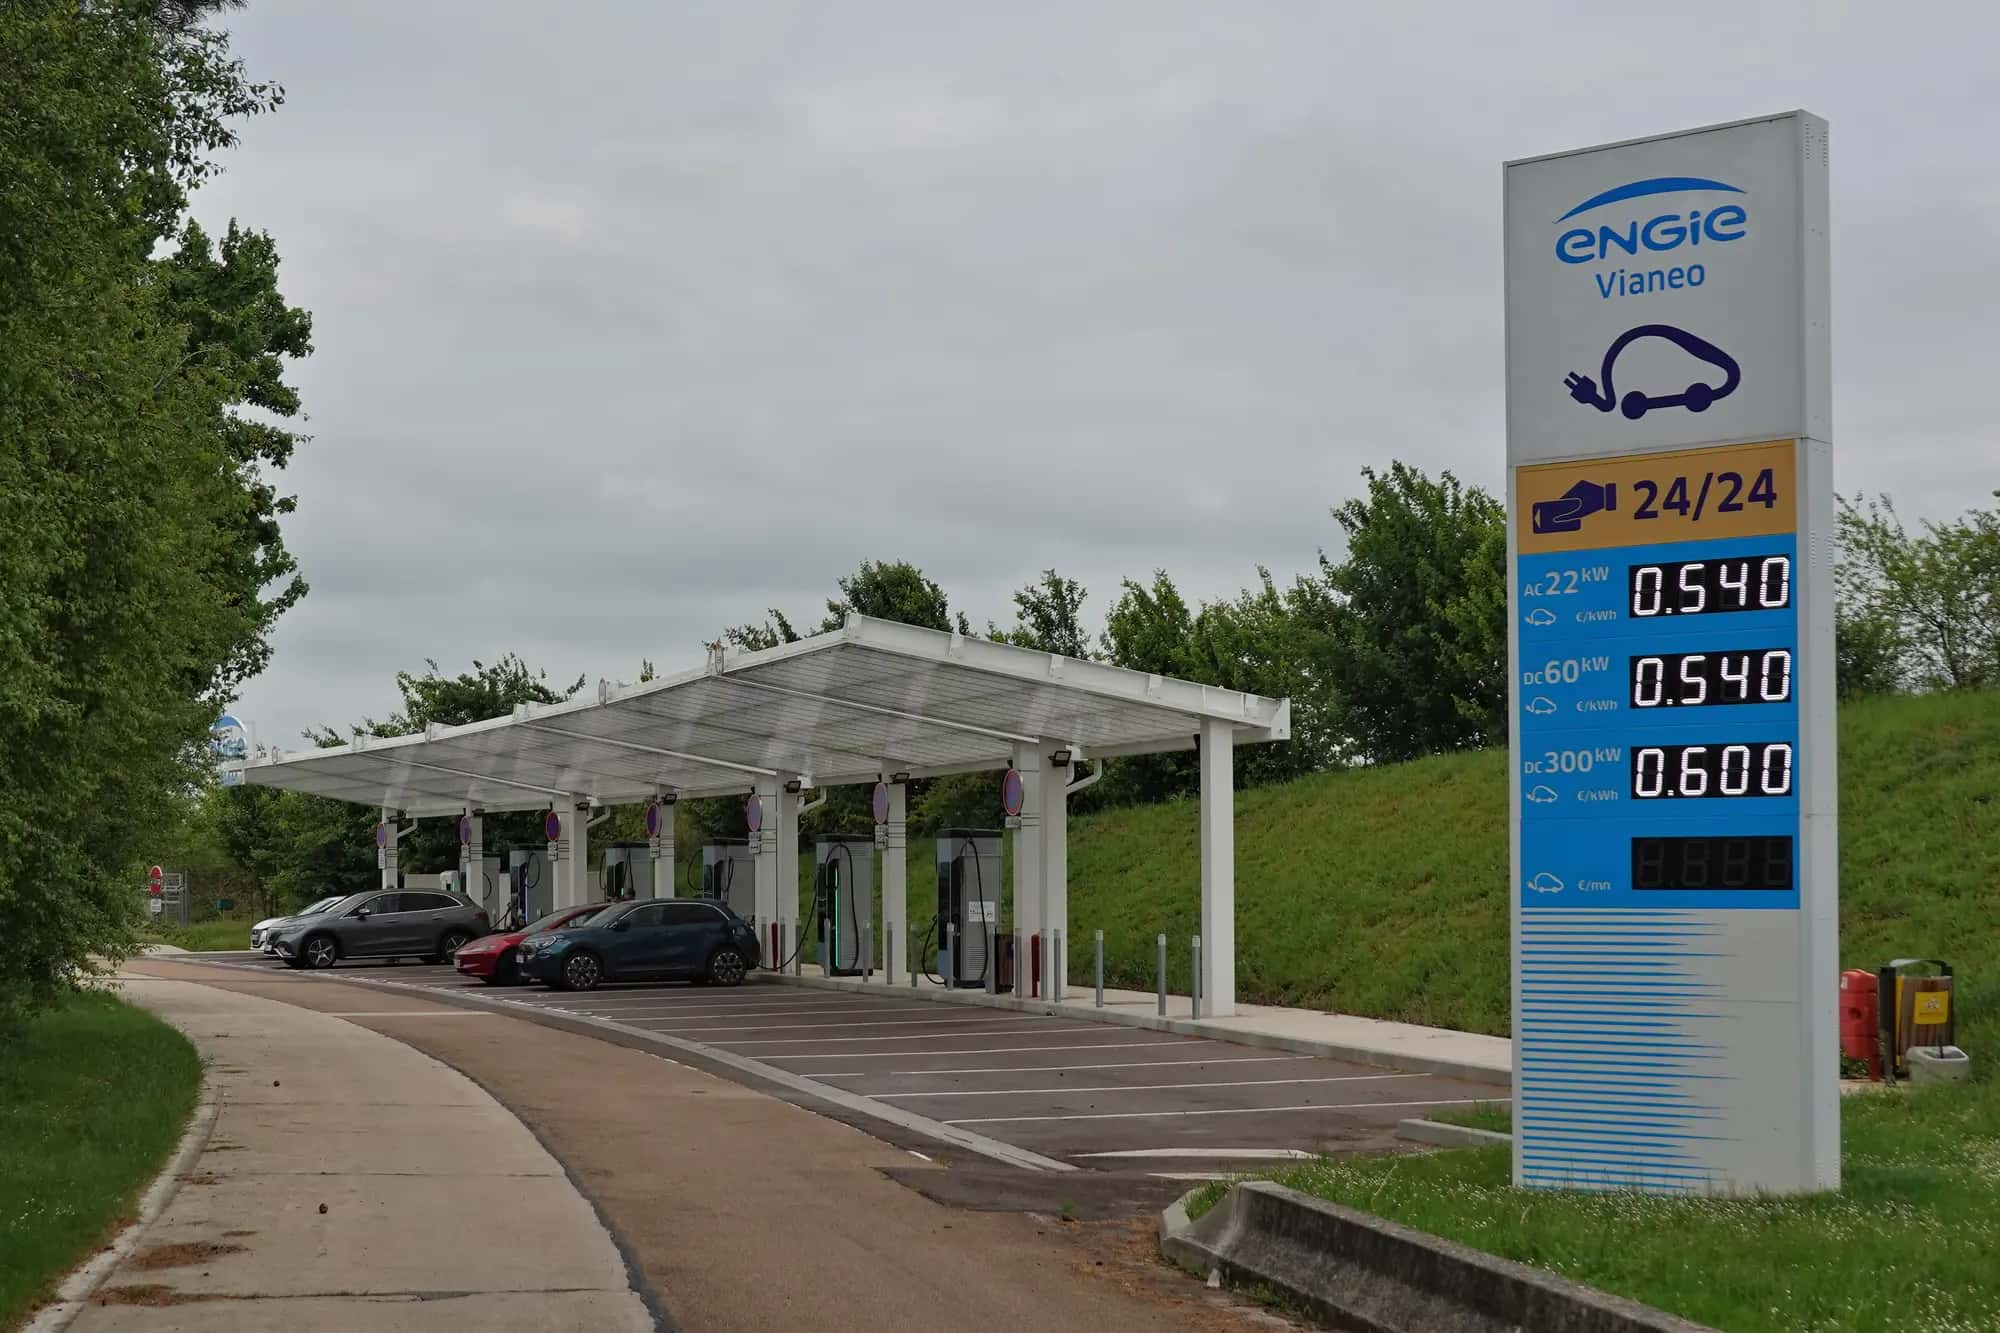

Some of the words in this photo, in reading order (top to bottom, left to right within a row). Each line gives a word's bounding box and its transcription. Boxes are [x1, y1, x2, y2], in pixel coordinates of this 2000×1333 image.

[1595, 264, 1705, 299] Vianeo
[1633, 468, 1778, 521] 24/24
[1633, 556, 1790, 616] 0.540
[1575, 609, 1617, 623] €/kWh
[1634, 650, 1791, 707] 0.540
[1576, 699, 1618, 712] €/kWh
[1635, 743, 1792, 797] 0.600
[1577, 789, 1619, 802] €/kWh
[1578, 880, 1611, 892] €/mn
